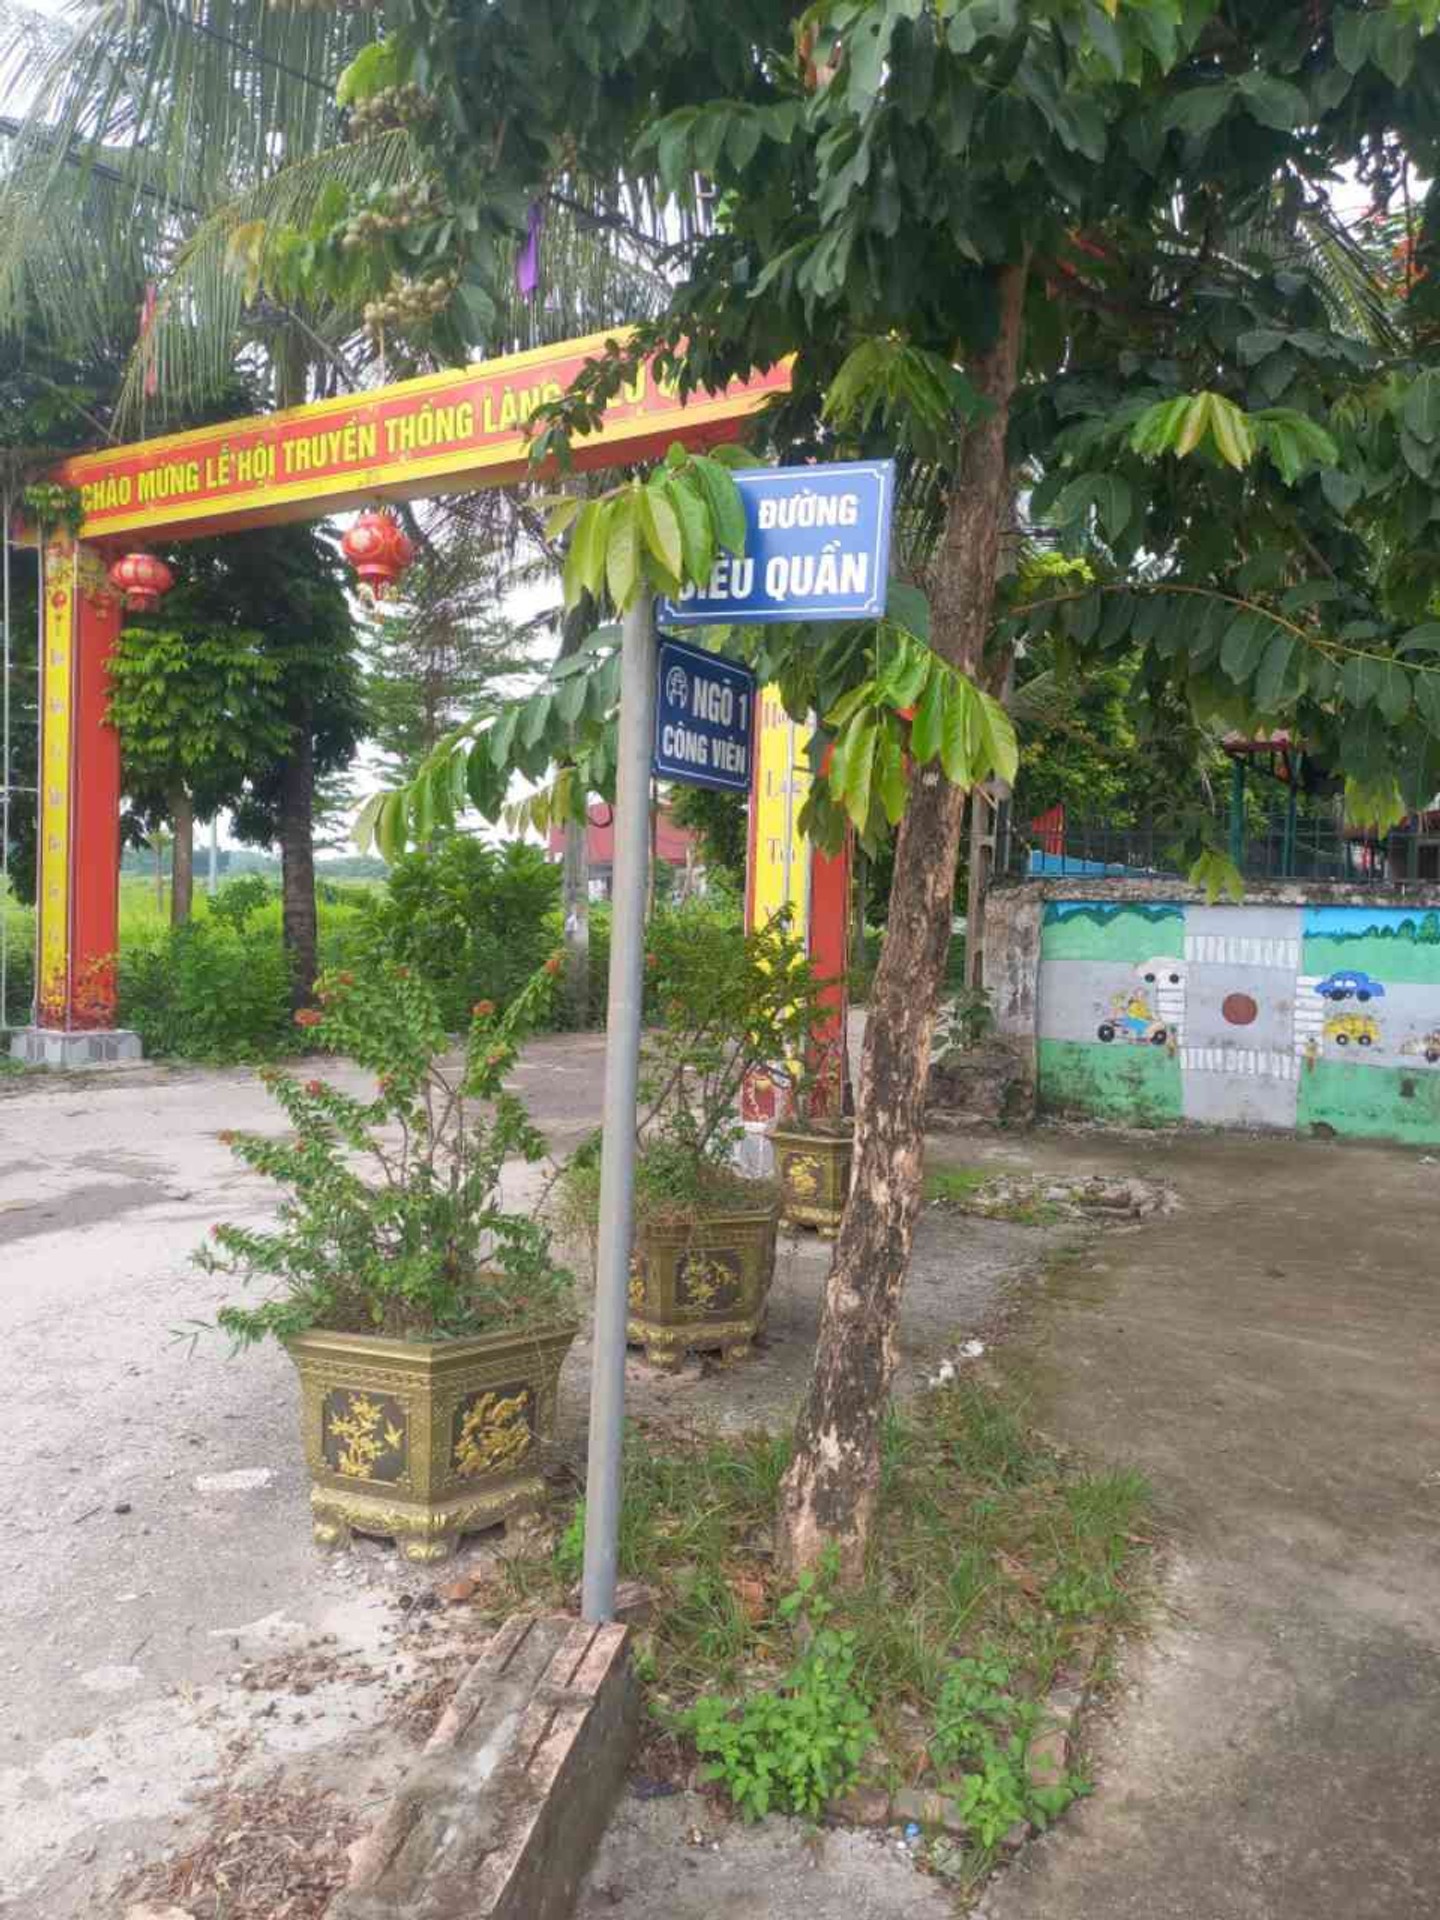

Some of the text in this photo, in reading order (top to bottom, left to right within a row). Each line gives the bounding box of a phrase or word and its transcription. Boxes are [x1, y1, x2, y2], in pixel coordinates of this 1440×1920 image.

[81, 473, 131, 512] CHÀO
[138, 460, 199, 502] MỪNG
[238, 439, 276, 488] HỘI
[282, 414, 377, 474] TRUYỀN
[384, 398, 473, 454] THỐNG
[758, 487, 858, 530] ĐƯỜNG
[765, 539, 868, 602] QUẦN
[693, 674, 733, 727] NGÕ
[738, 693, 748, 731] 1
[662, 720, 746, 775] CÔNG VIÊN
